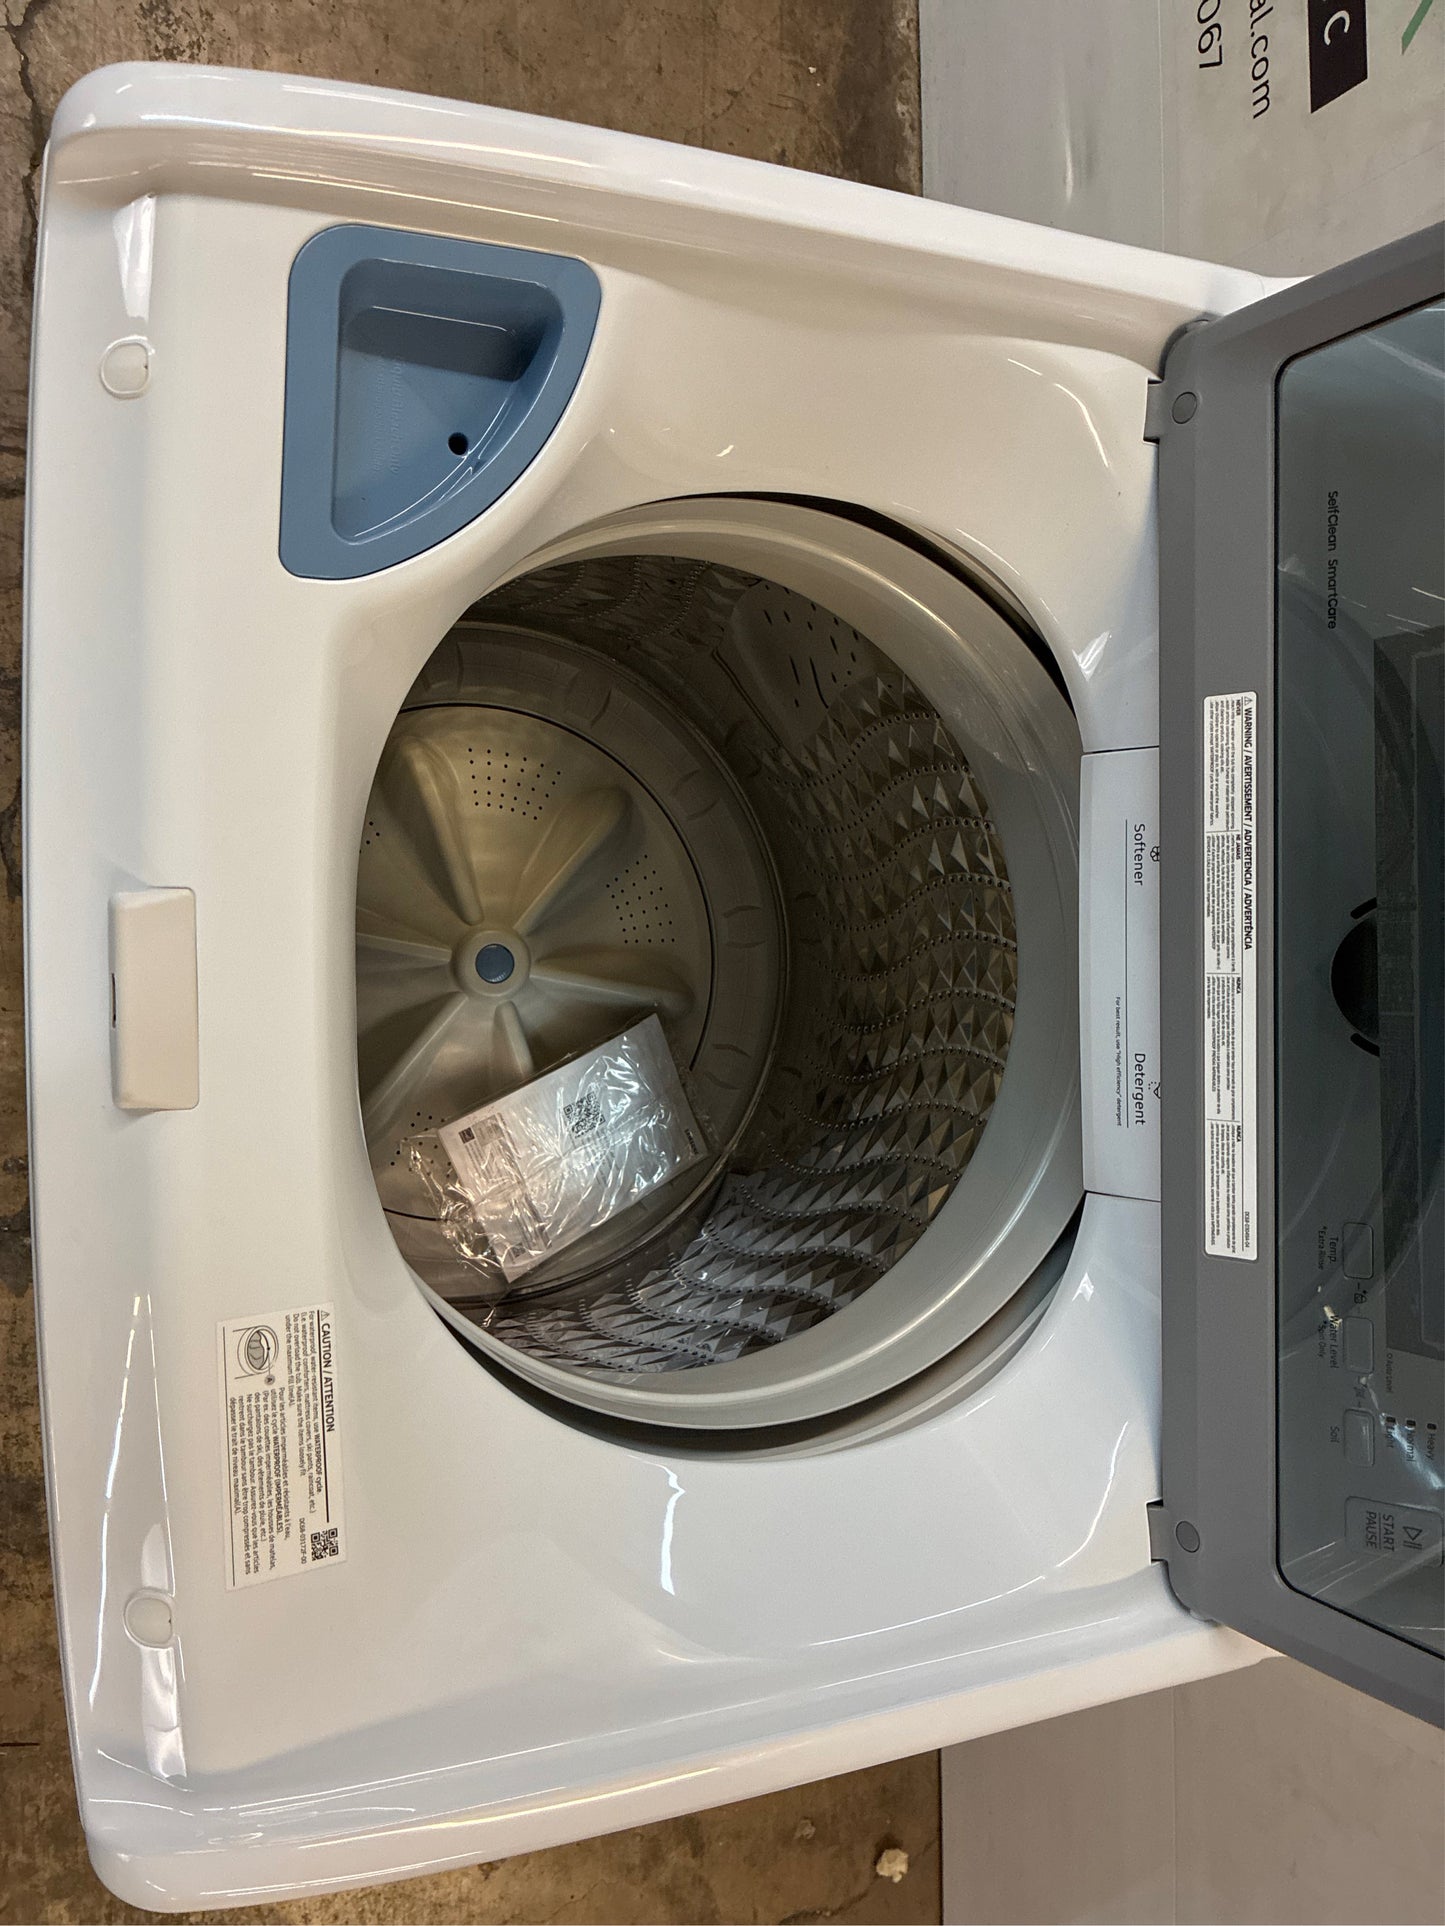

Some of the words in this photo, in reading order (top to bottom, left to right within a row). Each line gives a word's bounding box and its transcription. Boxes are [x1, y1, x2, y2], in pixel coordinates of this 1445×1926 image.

[1324, 10, 1350, 45] C
[1328, 490, 1339, 551] SelfClean
[1328, 559, 1338, 629] SmartCare
[1244, 708, 1252, 748] WARNING
[1244, 755, 1252, 822] AVERTISSEMENT
[1134, 824, 1146, 886] Softener
[1244, 829, 1252, 886] ADVERTENCIA
[1244, 893, 1254, 950] ADVERTÊNCIA
[1132, 1053, 1146, 1125] Detergent
[1328, 1237, 1339, 1264] Temp.
[301, 1324, 309, 1356] waterproof
[322, 1323, 332, 1368] CAUTION
[1330, 1315, 1339, 1341] Water
[1330, 1344, 1339, 1368] Level
[247, 1394, 253, 1402] Ne
[293, 1313, 299, 1322] Do
[297, 1447, 305, 1468] loosely
[311, 1356, 319, 1401] water-resistant
[246, 1404, 255, 1437] surchargez
[324, 1377, 334, 1432] ATTENTION
[271, 1419, 279, 1434] cycle
[1330, 1426, 1340, 1443] Soil
[1384, 1426, 1394, 1448] Light
[1426, 1433, 1435, 1459] Heavy
[254, 1404, 262, 1434] pantalons
[259, 1501, 266, 1509] de
[314, 1434, 322, 1476] WATERPROOF
[315, 1477, 323, 1494] cycle.
[1366, 1510, 1377, 1549] PAUSE
[1383, 1514, 1394, 1552] START
